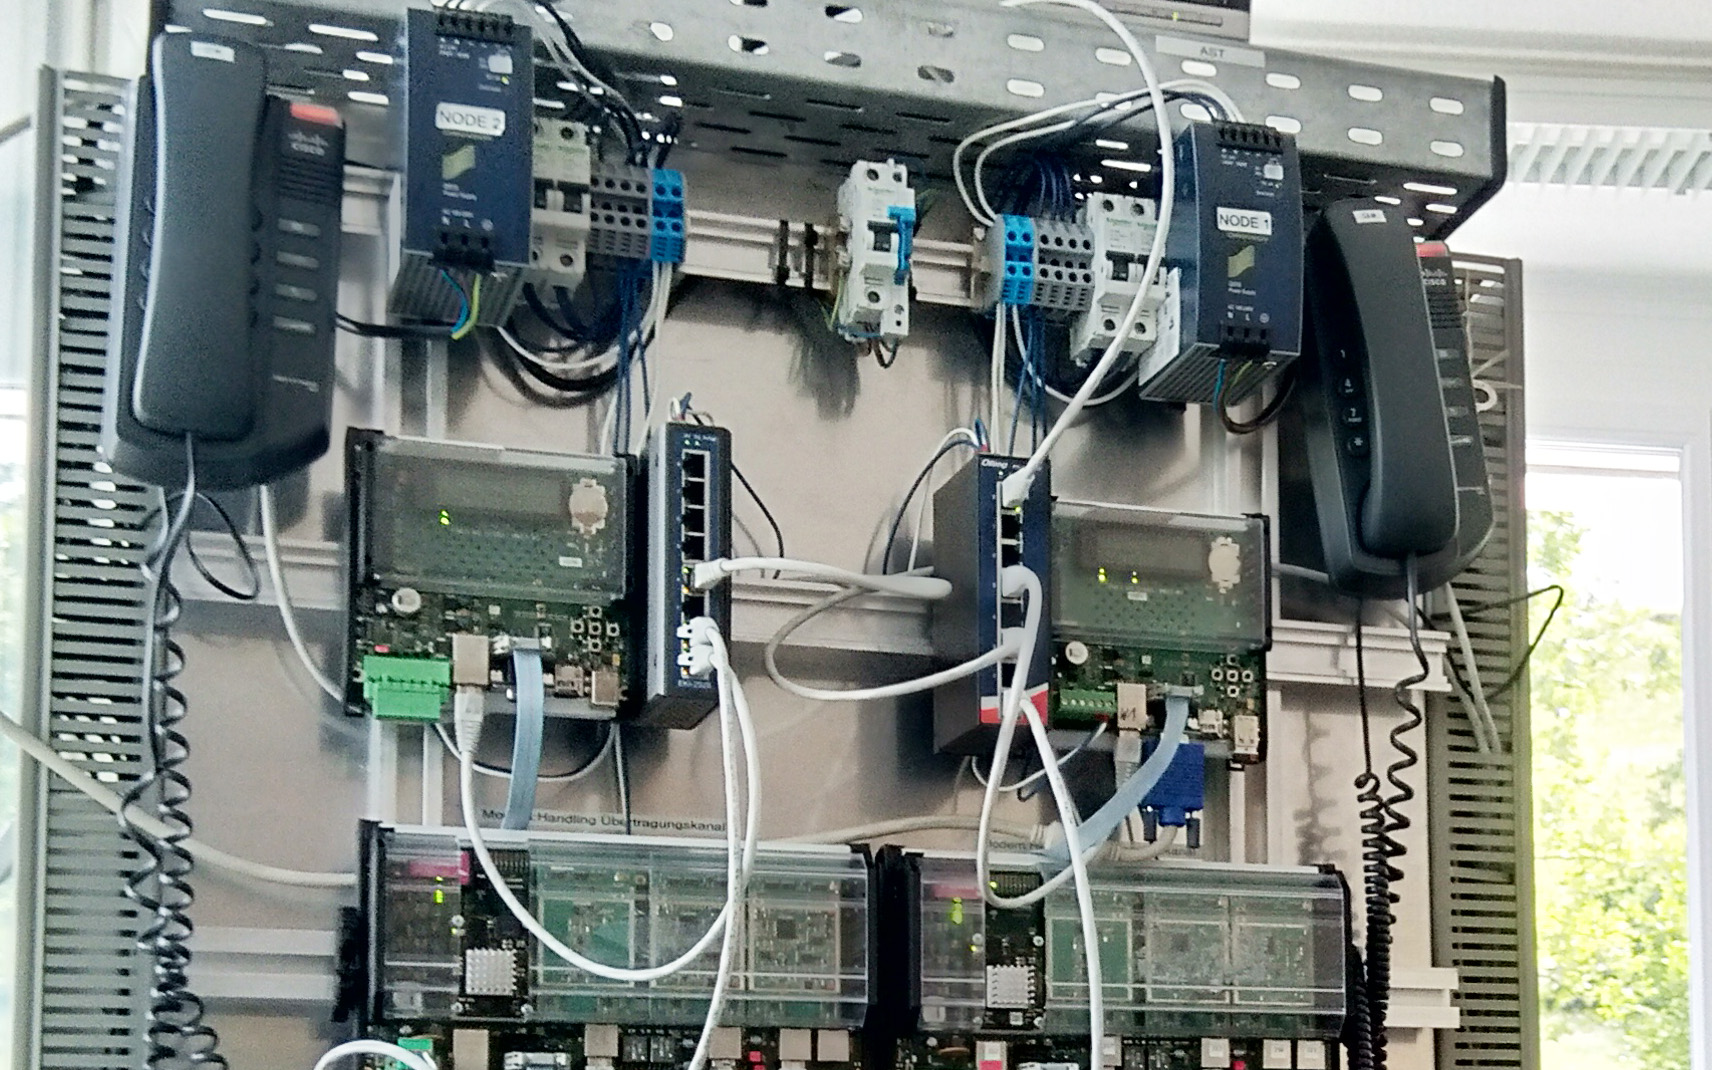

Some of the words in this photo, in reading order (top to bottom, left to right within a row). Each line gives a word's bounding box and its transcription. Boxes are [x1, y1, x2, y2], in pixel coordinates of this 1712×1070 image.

[439, 110, 488, 129] NODE
[493, 117, 502, 131] 2
[1219, 214, 1259, 229] NODE
[1264, 218, 1270, 230] 1
[537, 812, 597, 826] Handling
[601, 814, 727, 831] Übetragungskanal
